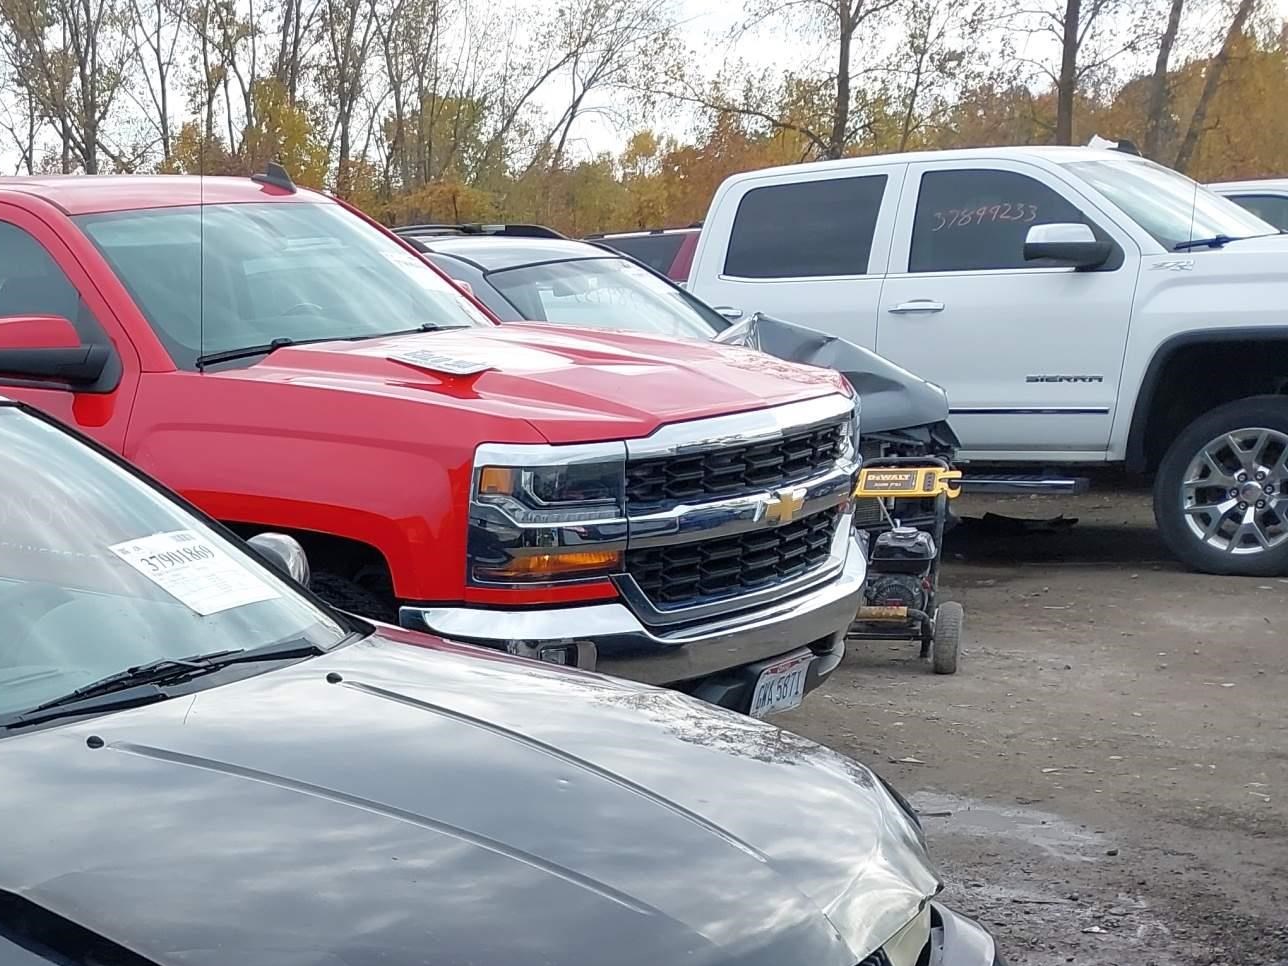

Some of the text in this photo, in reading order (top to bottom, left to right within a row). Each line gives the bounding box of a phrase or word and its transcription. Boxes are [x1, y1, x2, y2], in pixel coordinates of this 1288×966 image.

[931, 203, 1037, 232] 37899233
[1026, 375, 1103, 383] SIERRA
[140, 544, 215, 572] 37901869
